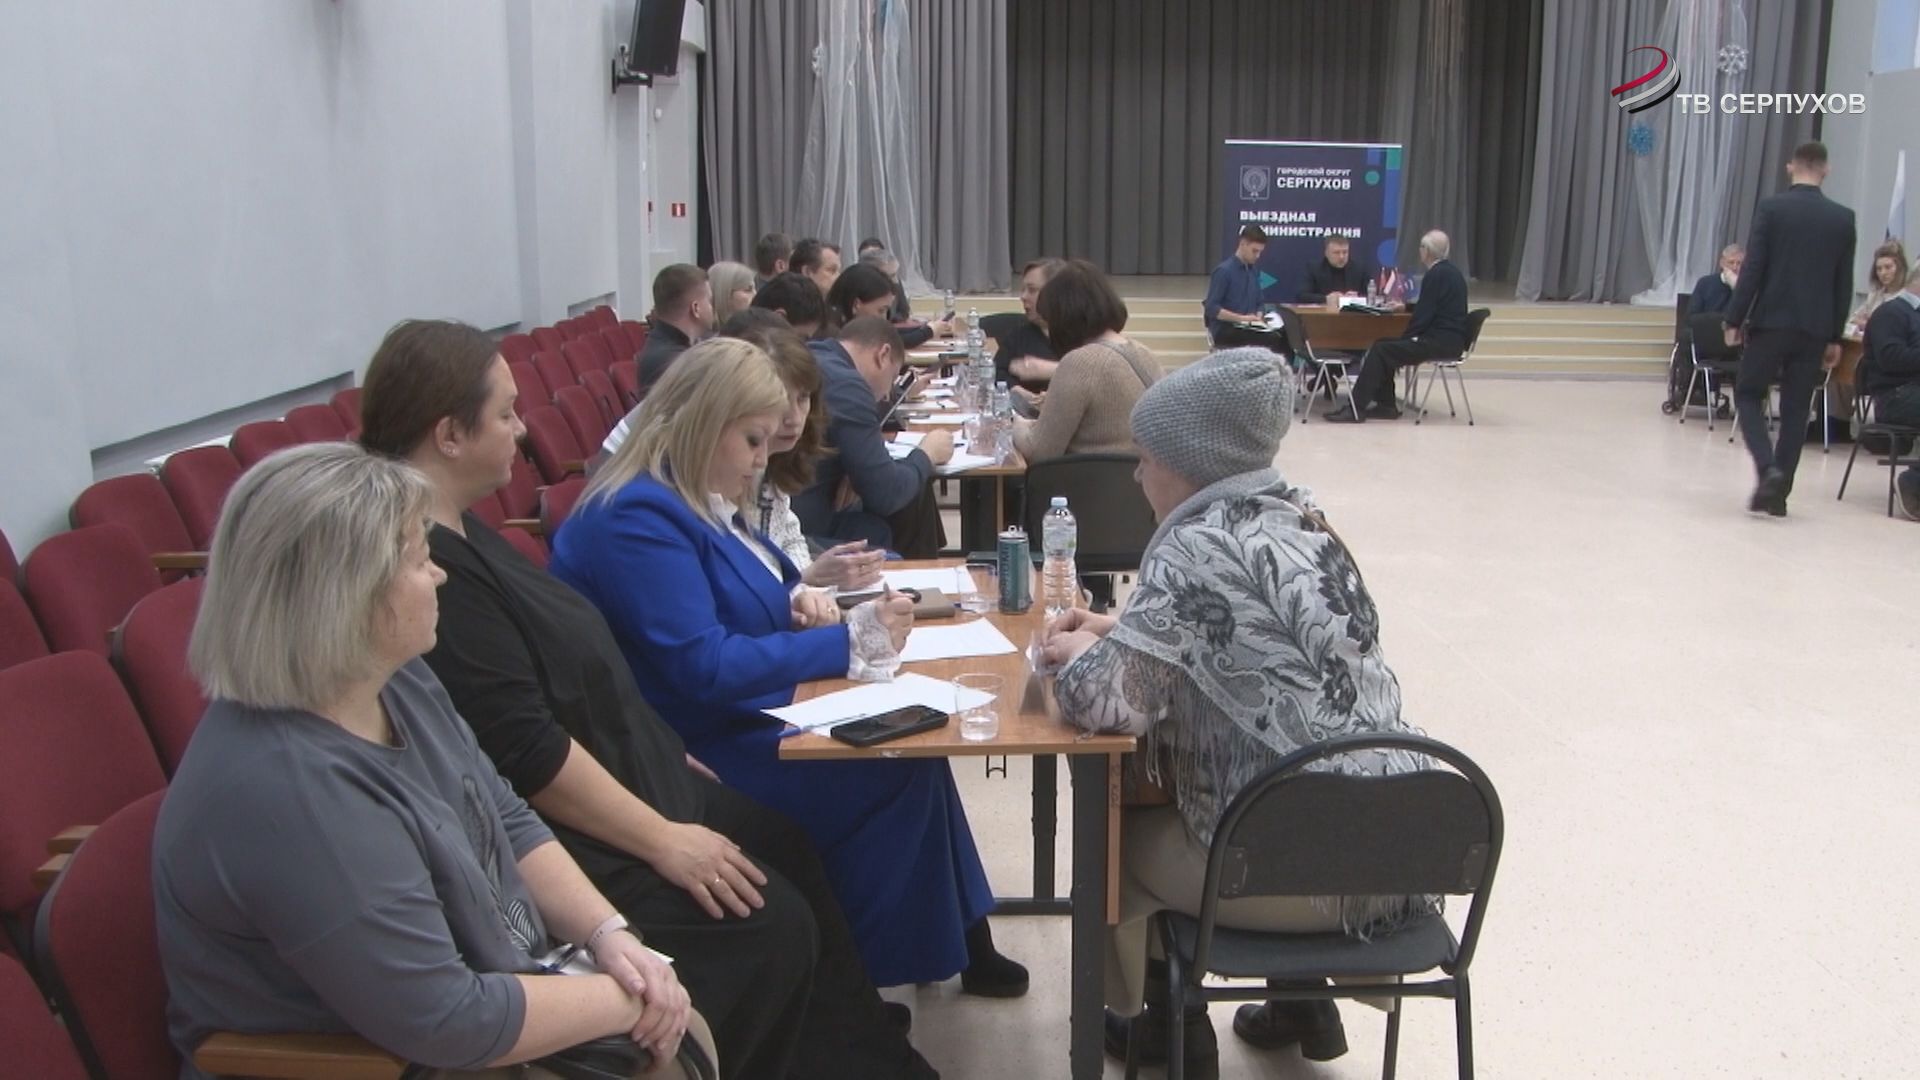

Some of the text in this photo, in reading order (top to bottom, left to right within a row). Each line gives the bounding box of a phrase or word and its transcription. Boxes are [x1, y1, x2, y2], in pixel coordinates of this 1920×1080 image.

[1277, 167, 1351, 176] ГОРОДСКОЙ ОКРУГ
[1277, 177, 1351, 190] СЕРПУХОВ
[1240, 211, 1316, 222] ВЫЕЗДНАЯ
[1239, 225, 1361, 238] МИНИСТРАЦИЯ
